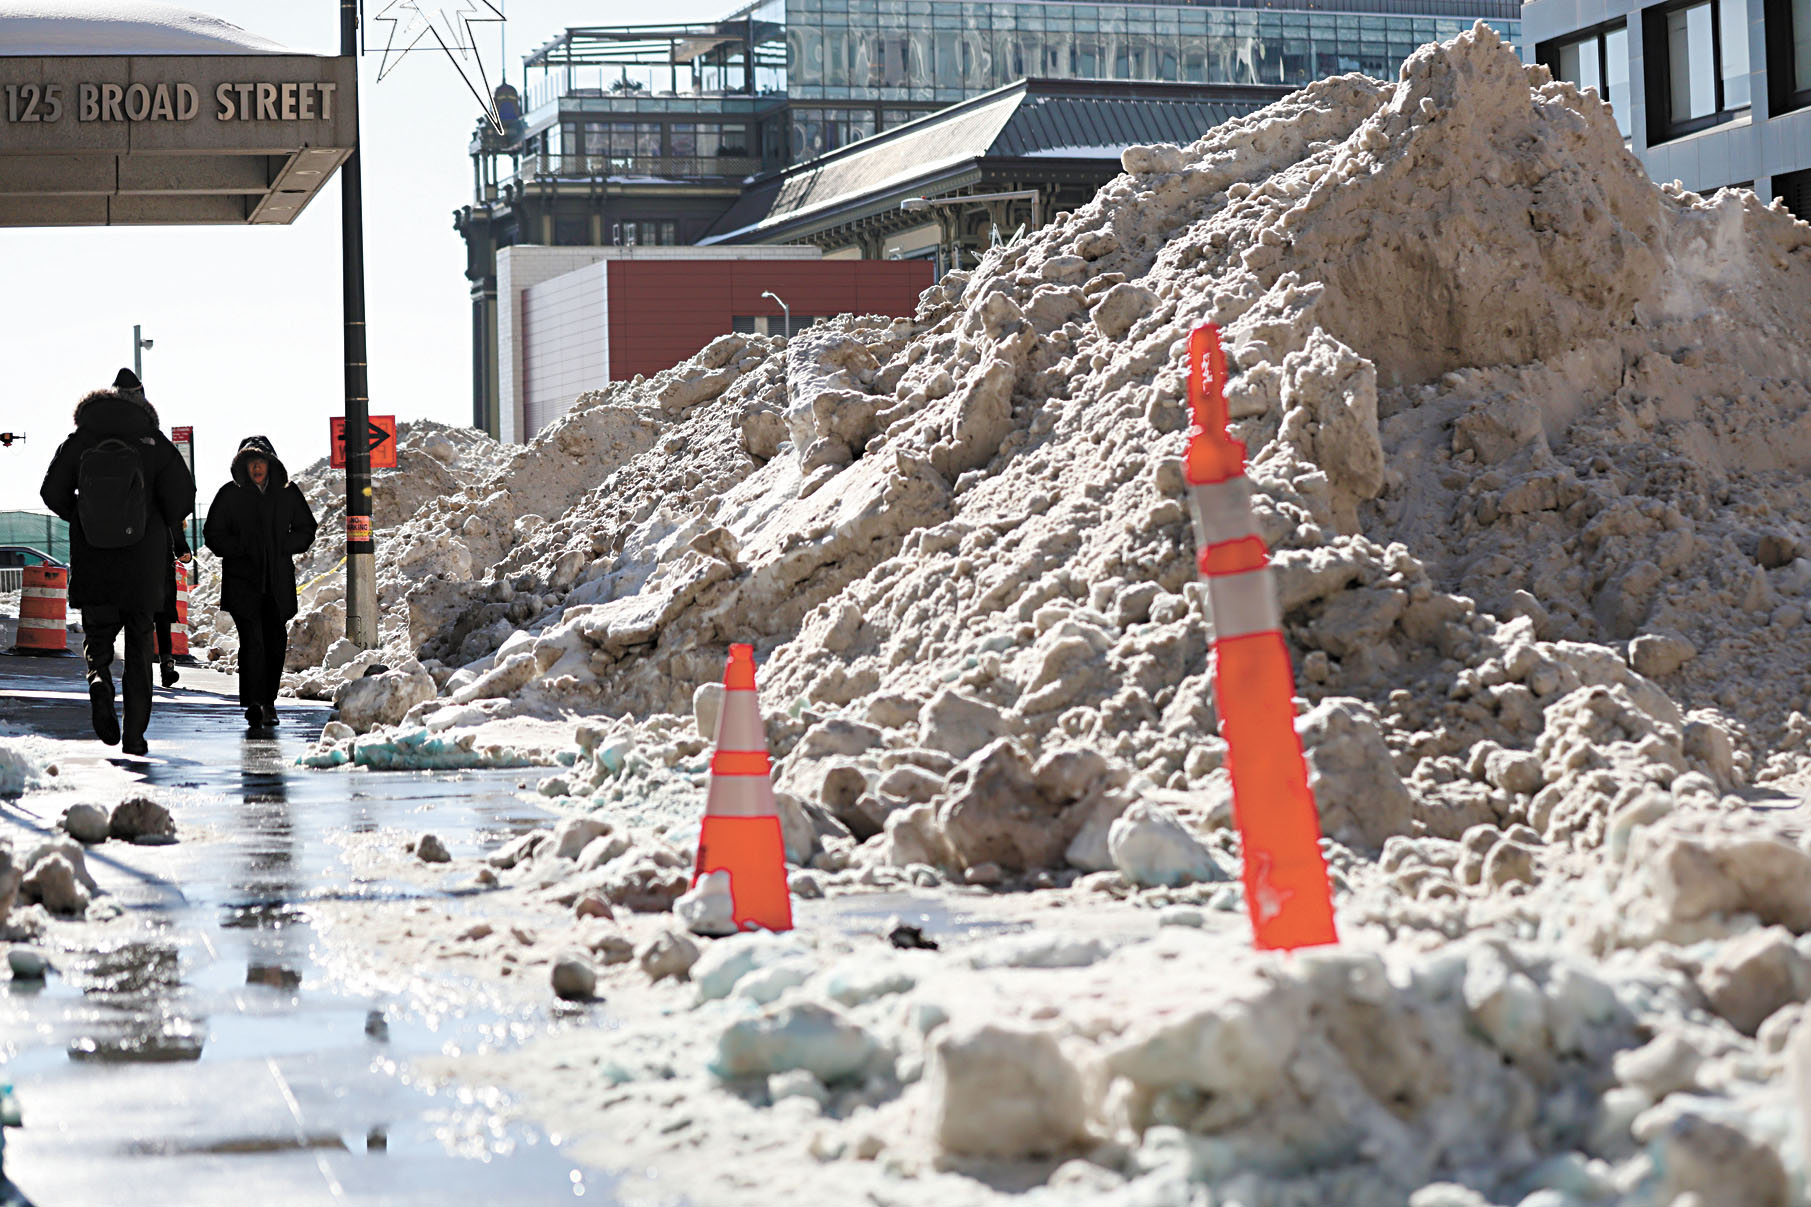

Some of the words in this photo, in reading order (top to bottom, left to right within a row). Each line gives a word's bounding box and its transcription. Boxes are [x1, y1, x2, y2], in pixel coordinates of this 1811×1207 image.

[5, 84, 64, 123] 125
[79, 83, 199, 122] BROAD
[216, 82, 336, 121] STREET
